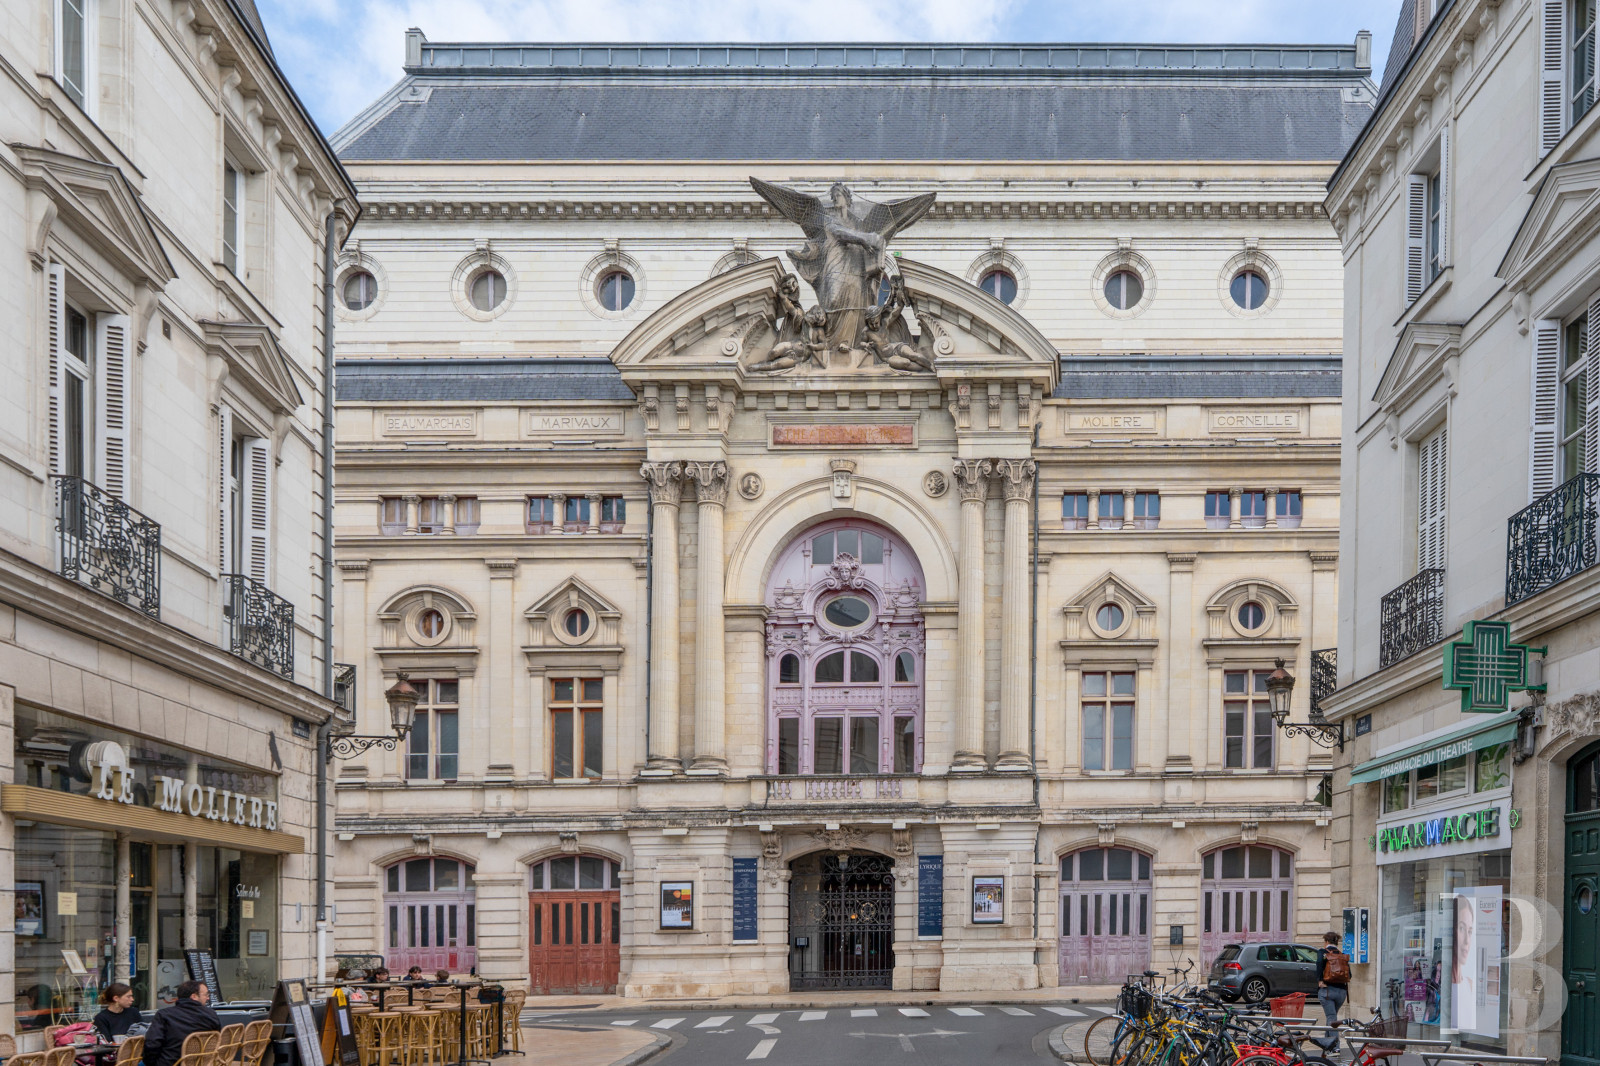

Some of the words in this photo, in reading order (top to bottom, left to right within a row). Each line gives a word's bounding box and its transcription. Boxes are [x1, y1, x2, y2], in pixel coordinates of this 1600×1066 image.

[387, 418, 471, 430] BEAUMARCHAIS
[541, 417, 611, 429] MARIVAUX
[1081, 416, 1142, 427] MOLIERE
[1217, 415, 1293, 426] CORNEILLE
[784, 428, 838, 440] THEATRE
[842, 428, 903, 440] MUNICIPAL
[1380, 754, 1422, 778] PHARMACIE
[1422, 751, 1435, 766] DU
[1436, 738, 1473, 762] THEATRE
[91, 761, 135, 805] LE
[153, 775, 278, 831] MOLIERE
[1379, 807, 1500, 852] PHARMACIE
[1479, 901, 1497, 909] Eucerin
